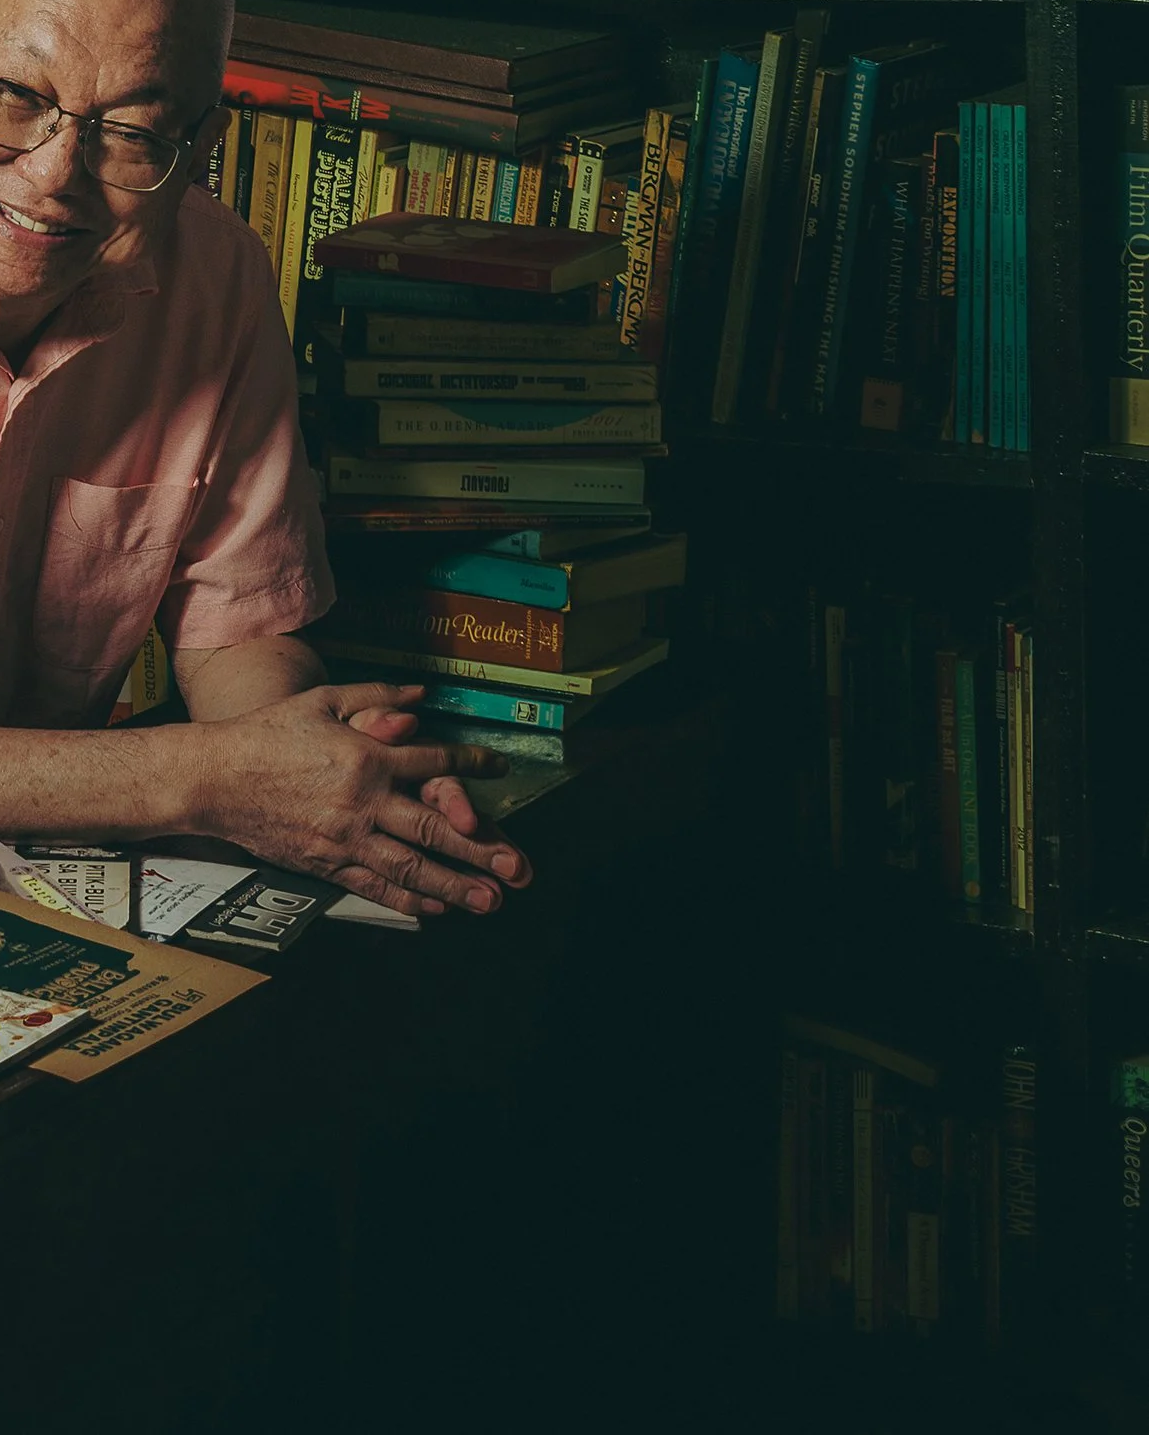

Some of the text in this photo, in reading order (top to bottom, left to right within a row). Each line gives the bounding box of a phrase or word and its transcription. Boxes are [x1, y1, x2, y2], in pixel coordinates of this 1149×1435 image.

[634, 143, 662, 249] BERGMAN
[814, 73, 866, 394] STEPHEN SONDHEIM FINISHING THE HAT
[1119, 164, 1149, 371] Film Quarterly
[460, 474, 509, 493] FOUCAULT
[452, 612, 524, 644] Reader
[61, 998, 173, 1052] GANTIMPALA
[81, 1004, 192, 1057] BULWAGANG
[1120, 1116, 1147, 1208] Queers
